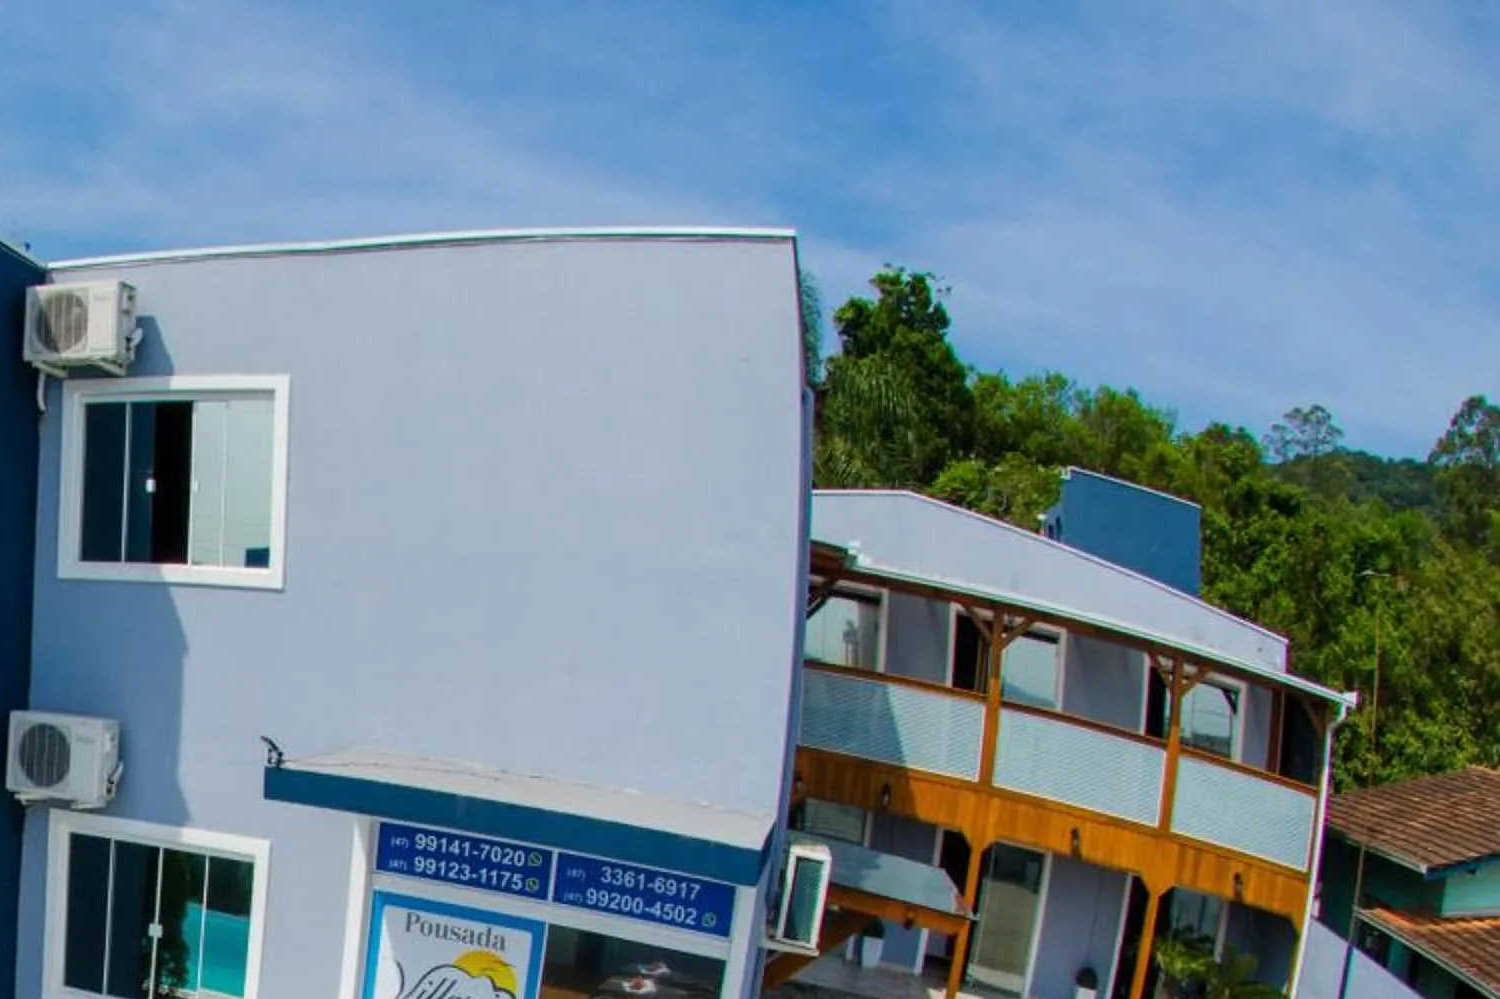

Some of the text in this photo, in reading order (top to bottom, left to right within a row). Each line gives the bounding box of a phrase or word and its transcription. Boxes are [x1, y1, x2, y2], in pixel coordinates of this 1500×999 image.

[414, 833, 525, 867] 99141-7020
[414, 857, 524, 890] 99123-1175
[600, 866, 701, 900] 3361-6917
[586, 888, 697, 925] 99200-4502
[405, 911, 506, 951] Pousada
